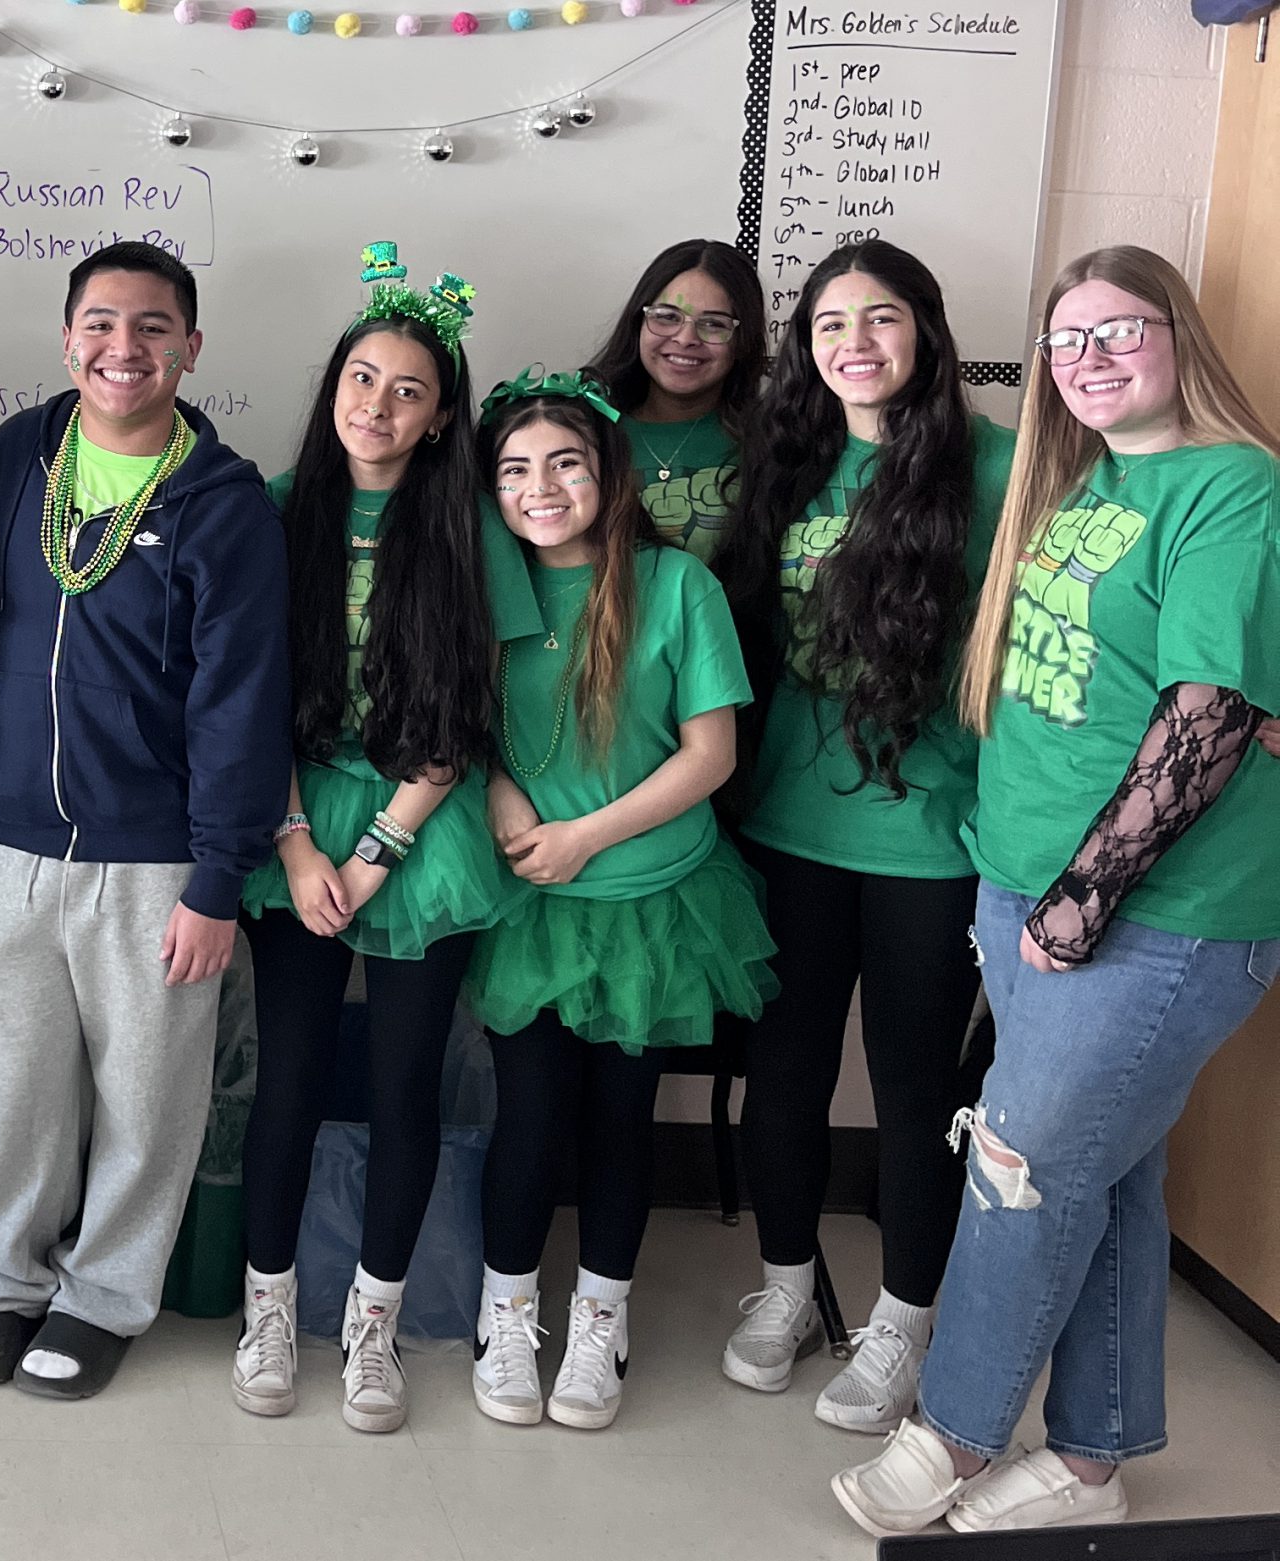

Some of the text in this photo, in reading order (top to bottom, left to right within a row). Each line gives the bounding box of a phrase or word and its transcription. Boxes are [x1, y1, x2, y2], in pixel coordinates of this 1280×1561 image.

[786, 6, 1020, 36] Mrs. Golden's Schedule
[840, 62, 880, 89] prep
[834, 94, 893, 119] Global
[832, 127, 887, 155] Study
[894, 131, 929, 151] Hall
[837, 160, 895, 183] Global
[124, 177, 182, 210] Rev
[837, 194, 894, 217] lunch
[835, 227, 880, 250] prep
[769, 320, 791, 344] 9t
[1010, 598, 1097, 676] RTLE
[1002, 645, 1088, 725] WER
